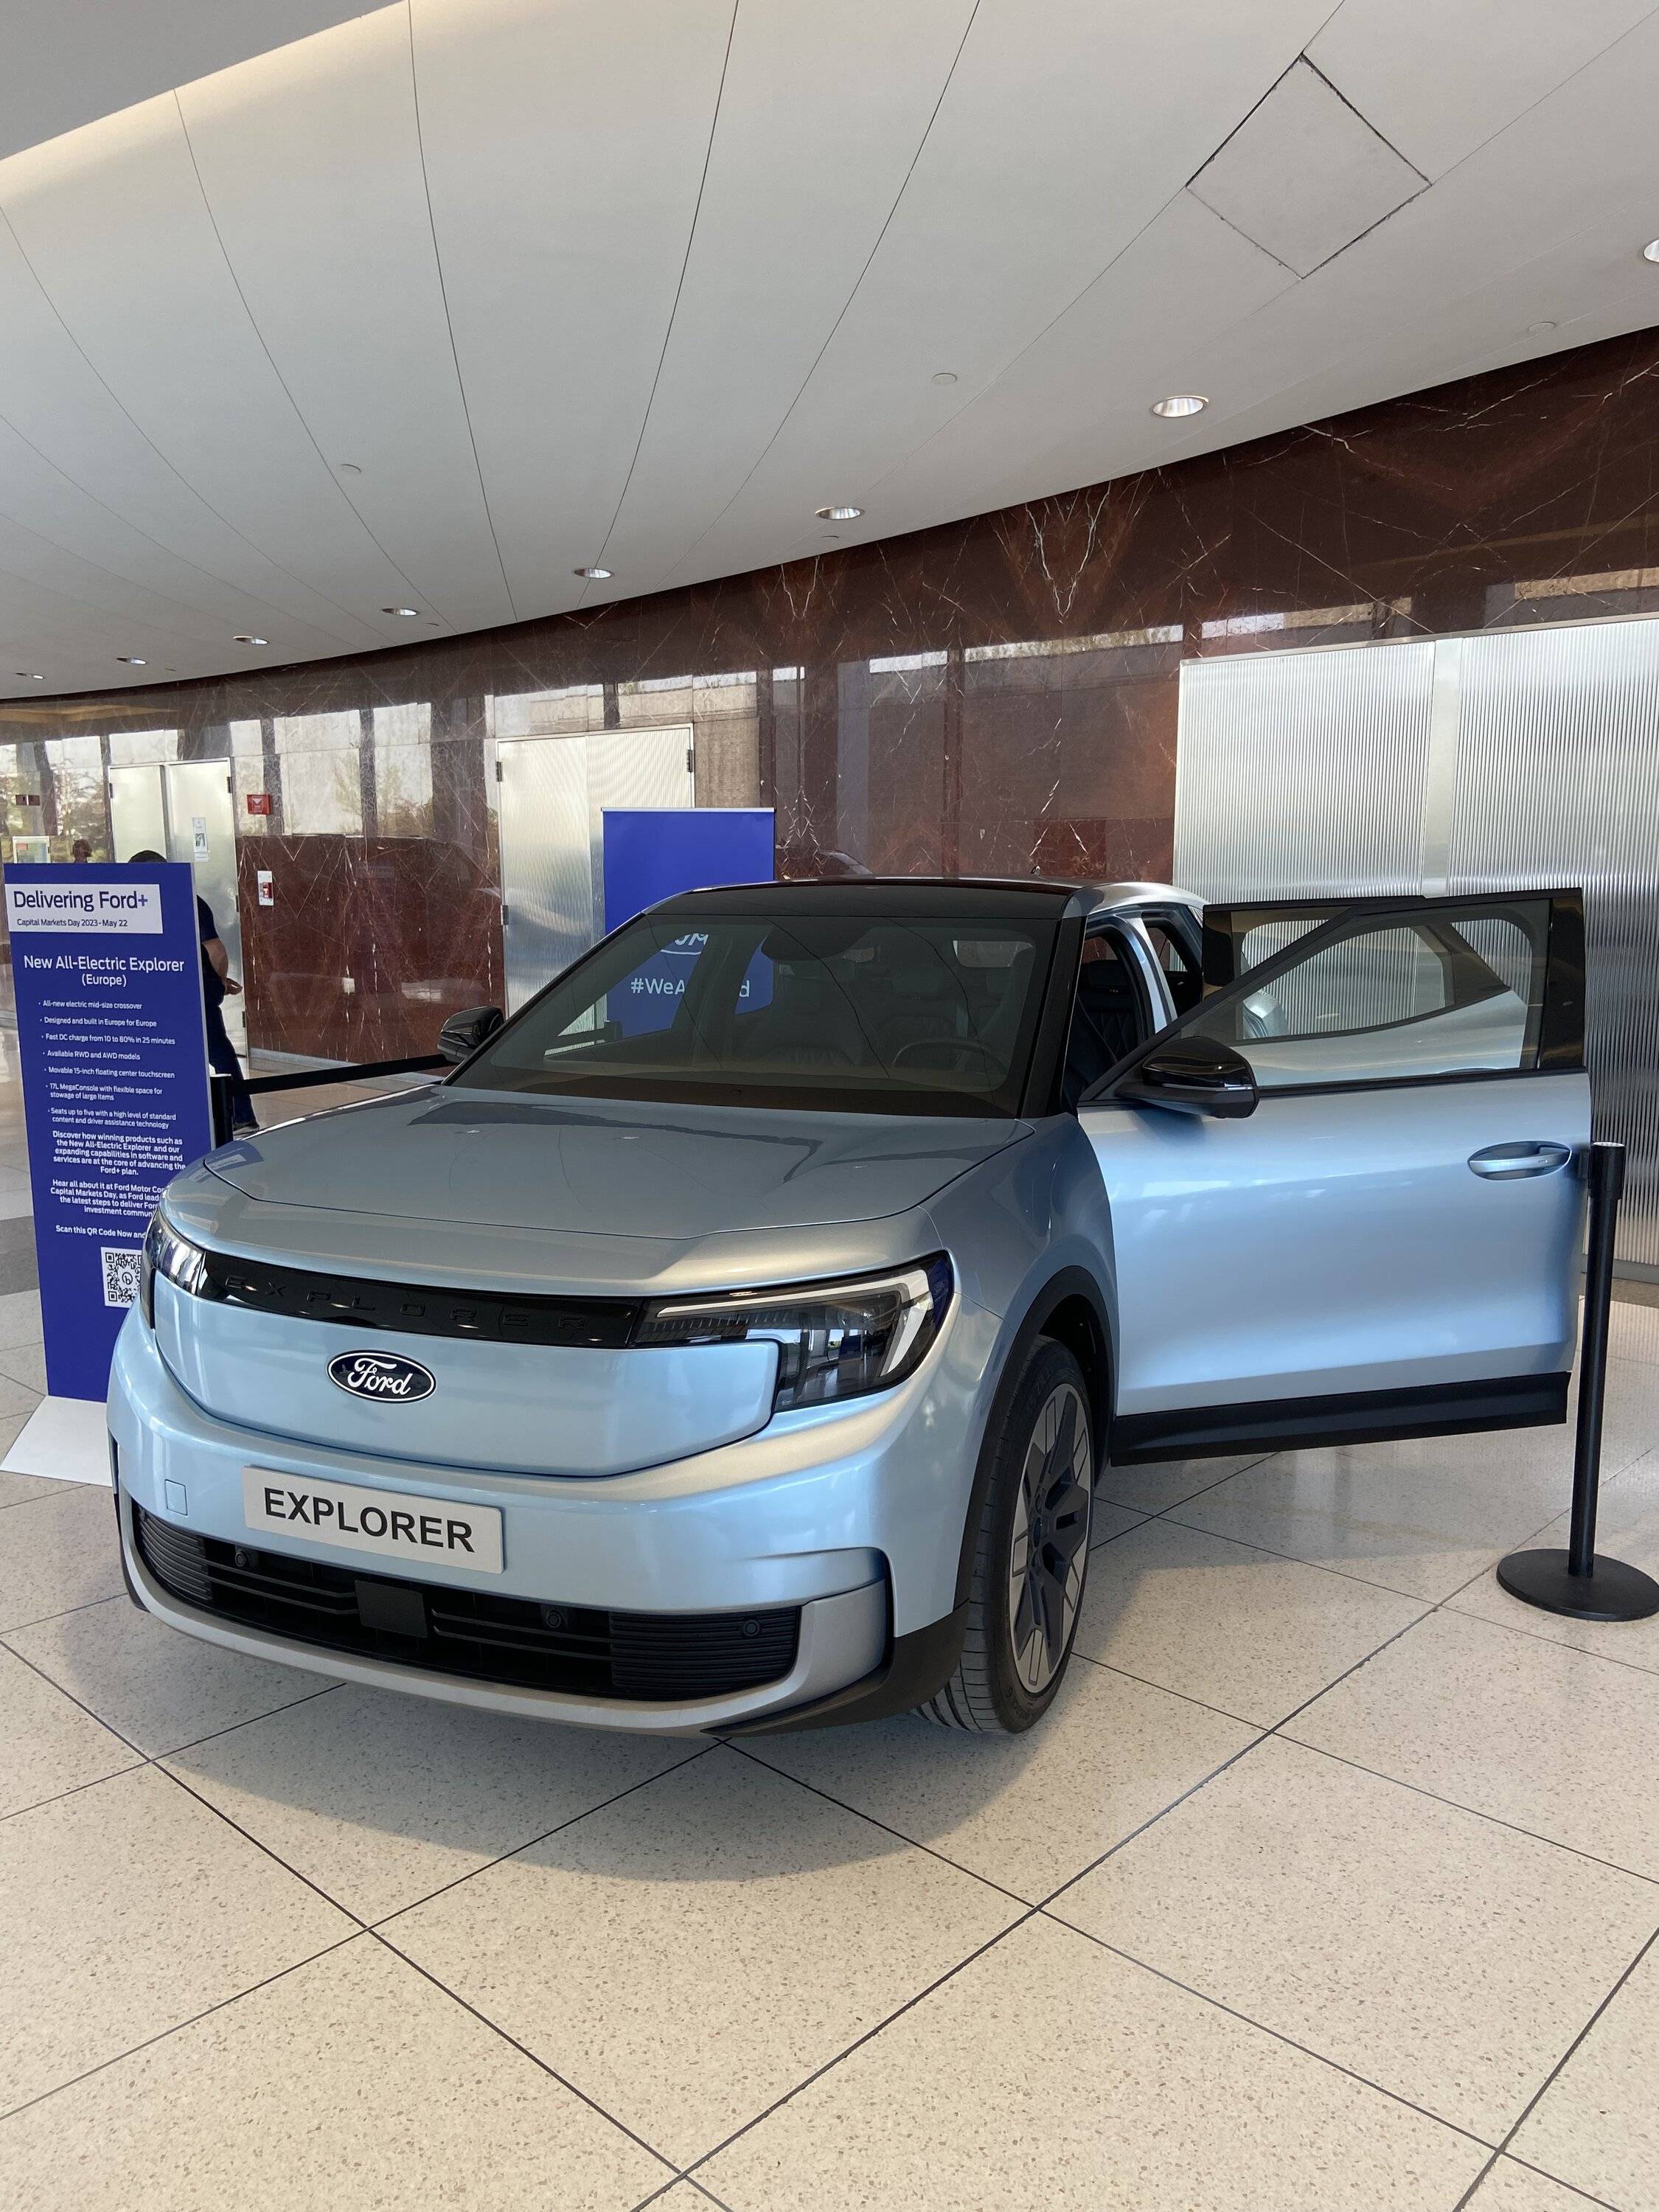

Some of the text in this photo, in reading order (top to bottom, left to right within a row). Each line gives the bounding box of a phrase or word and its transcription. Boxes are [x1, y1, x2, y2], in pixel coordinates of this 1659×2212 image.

[13, 891, 148, 912] Delivering Ford+
[17, 918, 39, 926] Capital
[68, 919, 80, 928] Day
[24, 956, 184, 973] New All-Electric Explorer
[82, 973, 127, 987] (Europe)
[88, 1001, 113, 1009] mid-size
[44, 1017, 71, 1025] Designed
[105, 1019, 125, 1027] Europe
[136, 1020, 157, 1028] Europe
[74, 1067, 94, 1075] 15-inch
[96, 1068, 118, 1077] floating
[138, 1071, 175, 1079] touchscreen
[60, 1084, 99, 1092] MegaConsole
[83, 1093, 97, 1101] large
[114, 1110, 126, 1119] high
[149, 1113, 176, 1121] standard
[104, 1119, 136, 1127] assistance
[136, 1120, 169, 1130] technology
[52, 1130, 81, 1139] Discover
[82, 1132, 97, 1140] how
[97, 1133, 125, 1142] winning
[125, 1135, 156, 1144] products
[85, 1141, 122, 1150] All-Electric
[123, 1143, 151, 1152] Explorer
[153, 1144, 167, 1152] and
[55, 1147, 89, 1157] expanding
[90, 1149, 130, 1158] capabilities
[138, 1152, 169, 1161] software
[100, 1166, 139, 1176] Ford+ plan.
[129, 1159, 137, 1167] of
[138, 1161, 173, 1171] advancing
[174, 1162, 186, 1170] the
[52, 1179, 69, 1187] Hear
[69, 1180, 78, 1188] all
[79, 1180, 99, 1189] about
[114, 1183, 130, 1192] Ford
[131, 1184, 151, 1193] Motor
[50, 1187, 74, 1195] Capital
[75, 1189, 102, 1197] Markets
[103, 1192, 118, 1200] Day,
[128, 1192, 144, 1200] Ford
[72, 1197, 91, 1205] latest
[119, 1200, 143, 1208] deliver
[84, 1206, 122, 1215] investment
[55, 1225, 72, 1234] Scan
[74, 1226, 86, 1234] this
[87, 1227, 98, 1237] QR
[98, 1228, 116, 1237] Code
[116, 1229, 133, 1237] Now
[224, 1275, 588, 1329] EXPLORER
[347, 1357, 413, 1395] Ford
[263, 1486, 475, 1553] EXPLORER
